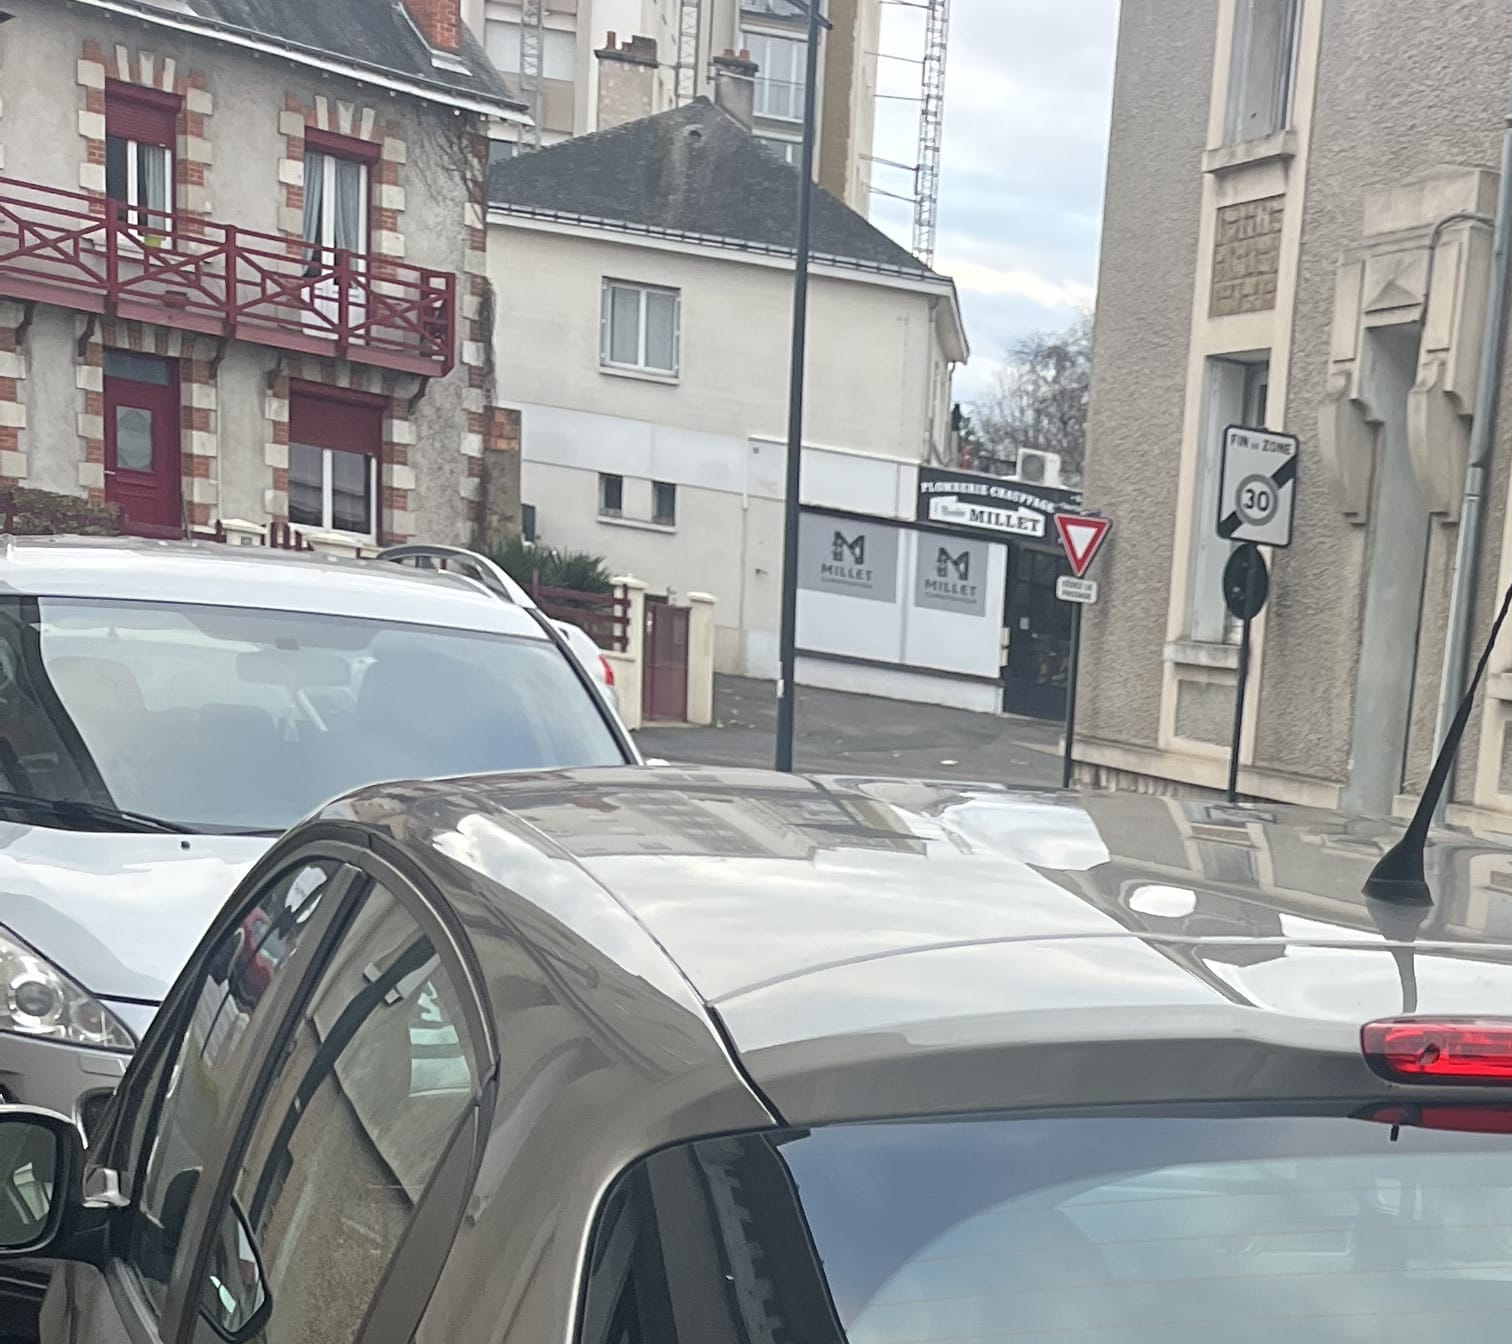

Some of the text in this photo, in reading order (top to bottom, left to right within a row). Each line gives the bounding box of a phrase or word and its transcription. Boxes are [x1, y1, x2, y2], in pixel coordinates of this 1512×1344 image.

[1262, 439, 1293, 455] ZONE
[1243, 488, 1270, 512] 30
[969, 508, 1042, 533] MILLET
[820, 563, 873, 582] MILLET
[924, 578, 977, 598] MILLET
